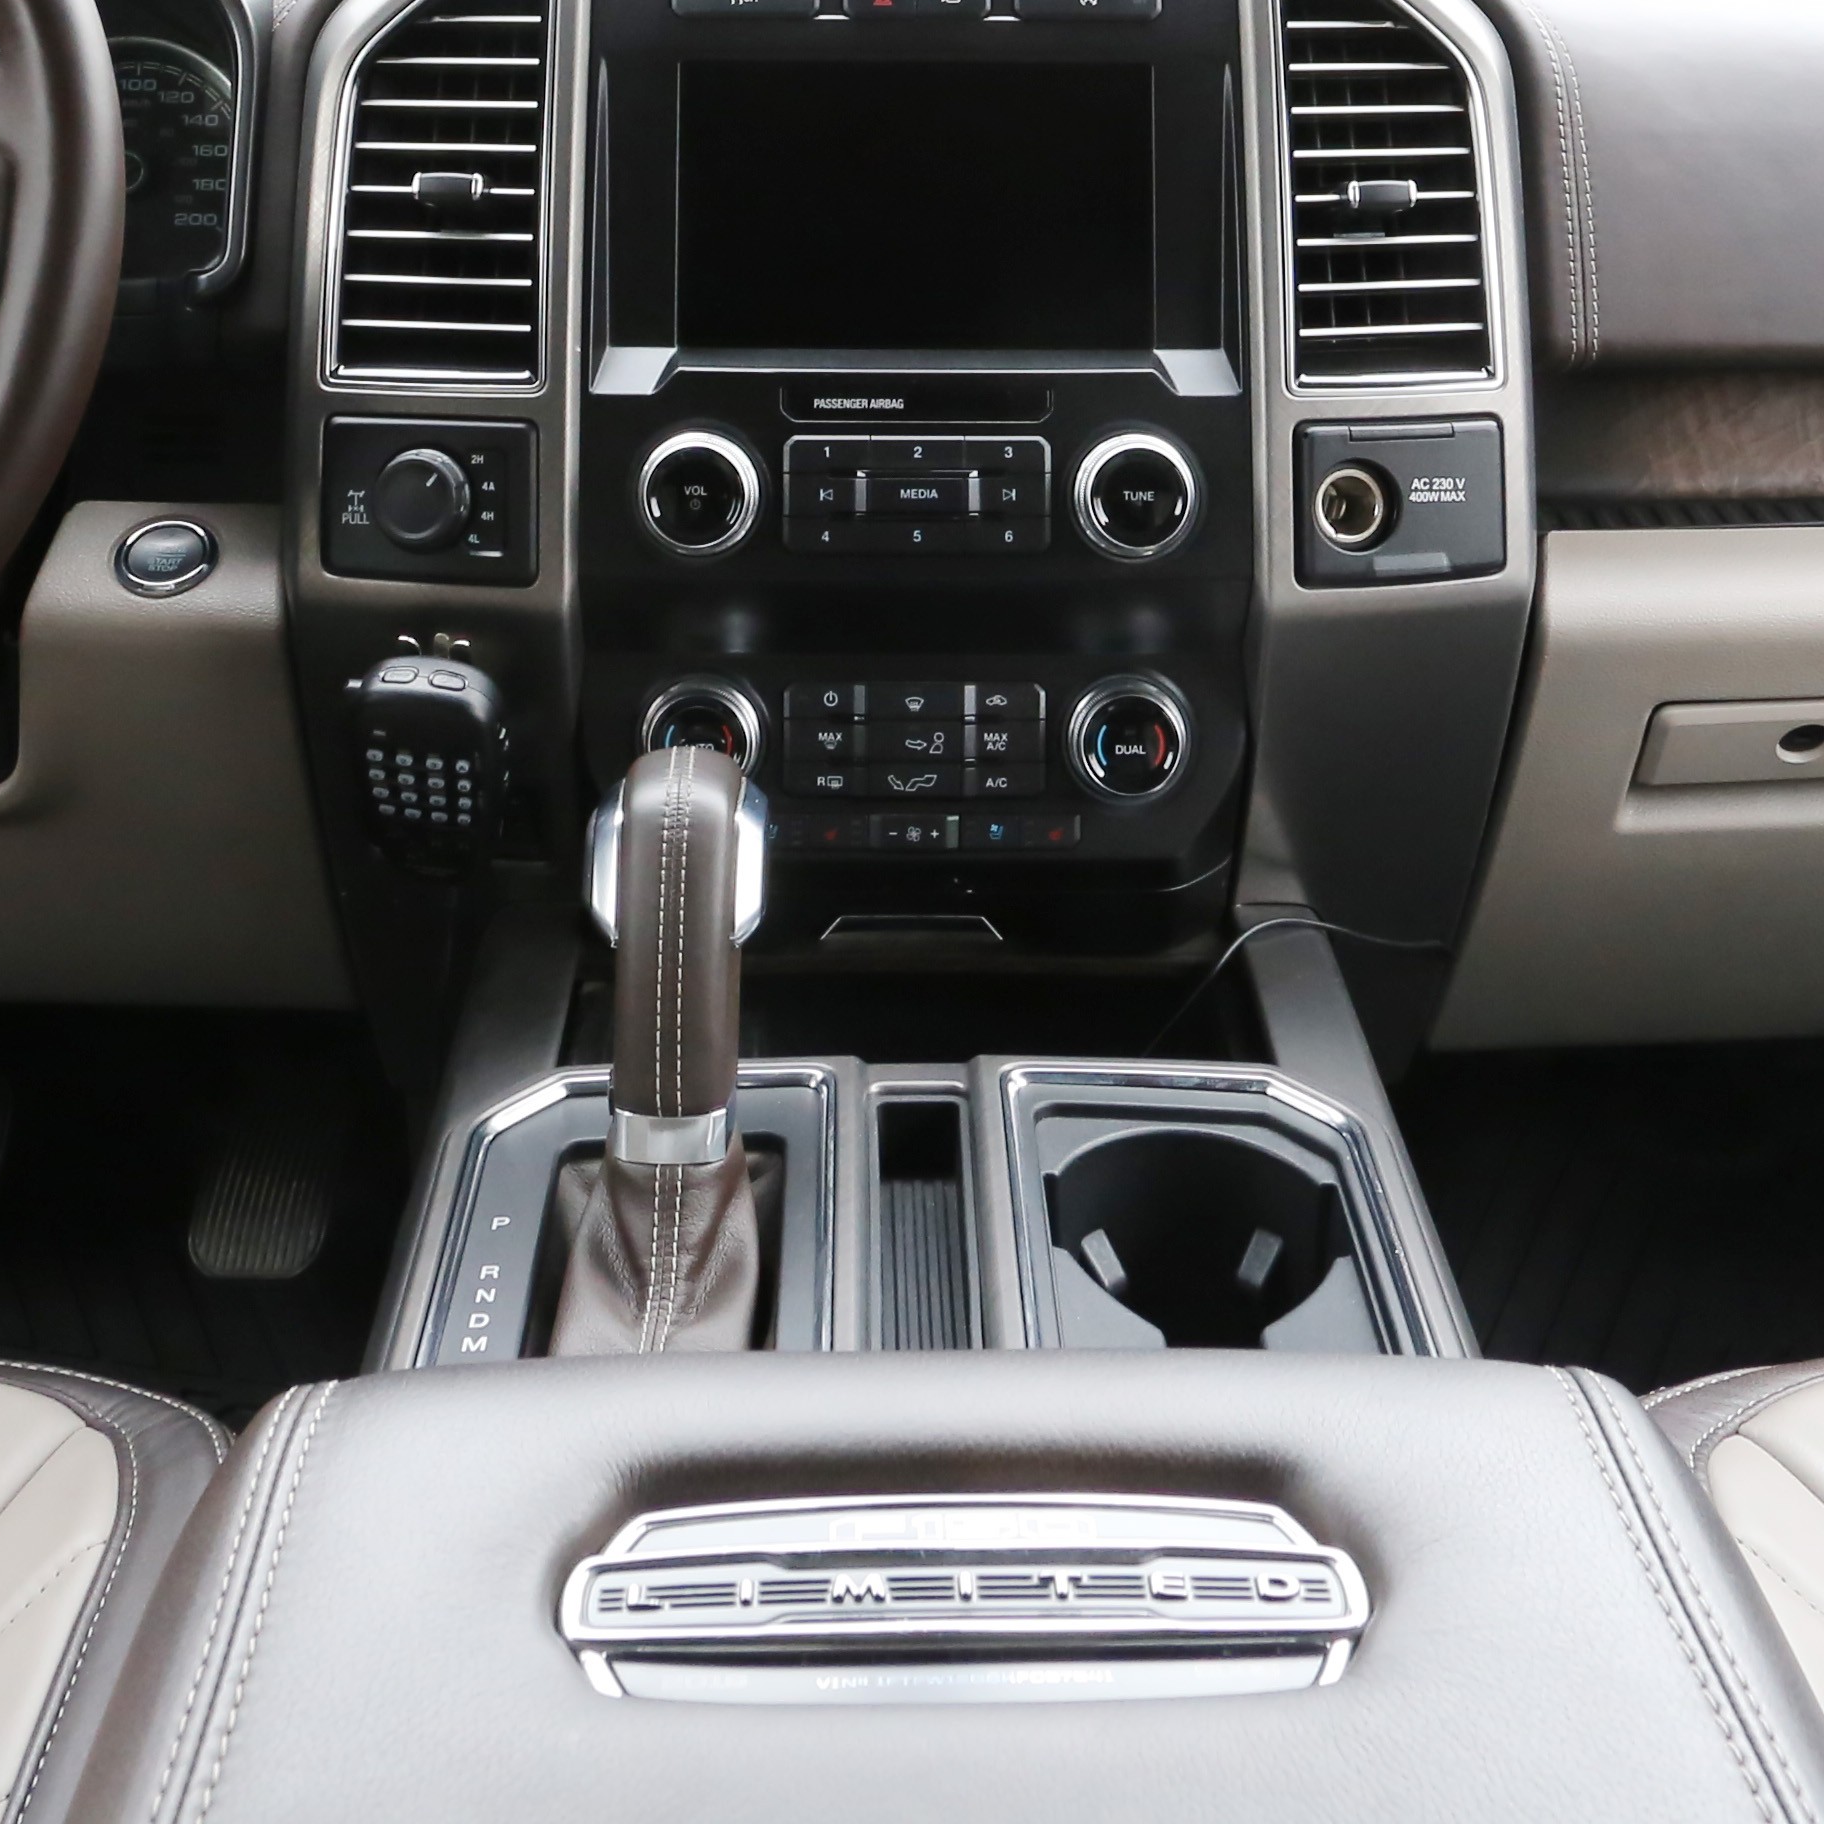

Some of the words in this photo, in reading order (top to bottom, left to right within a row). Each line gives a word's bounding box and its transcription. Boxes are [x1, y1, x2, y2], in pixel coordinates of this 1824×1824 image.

[119, 79, 157, 91] 100
[158, 91, 195, 104] 120
[181, 114, 219, 127] 140
[192, 144, 227, 157] 160
[174, 213, 218, 226] 200
[813, 398, 868, 409] PASSENGER
[869, 398, 905, 410] AIRBAG
[823, 446, 831, 458] 1
[913, 446, 923, 458] 2
[1004, 446, 1014, 458] 3
[471, 454, 484, 464] 2H
[481, 481, 496, 491] 4A
[1410, 477, 1431, 490] AC
[1431, 477, 1455, 490] 230
[1456, 477, 1466, 489] V
[684, 485, 708, 497] VOL
[900, 488, 939, 499] MEDIA
[1122, 490, 1156, 502] TUNE
[1440, 491, 1467, 503] MAX
[341, 512, 370, 525] PULL
[480, 511, 495, 522] 4H
[468, 533, 480, 544] 4L
[821, 530, 830, 543] 4
[912, 530, 922, 543] 5
[1004, 530, 1014, 543] 6
[818, 731, 843, 742] MAX
[983, 732, 1009, 742] MAX
[986, 741, 1007, 752] A/C
[1115, 744, 1147, 755] DUAL
[817, 776, 826, 787] R
[986, 778, 1008, 788] A/C
[491, 1216, 511, 1231] P
[479, 1264, 501, 1281] R
[475, 1287, 496, 1304] N
[468, 1313, 490, 1329] D
[461, 1335, 488, 1353] M
[625, 1569, 1304, 1610] LIMITED
